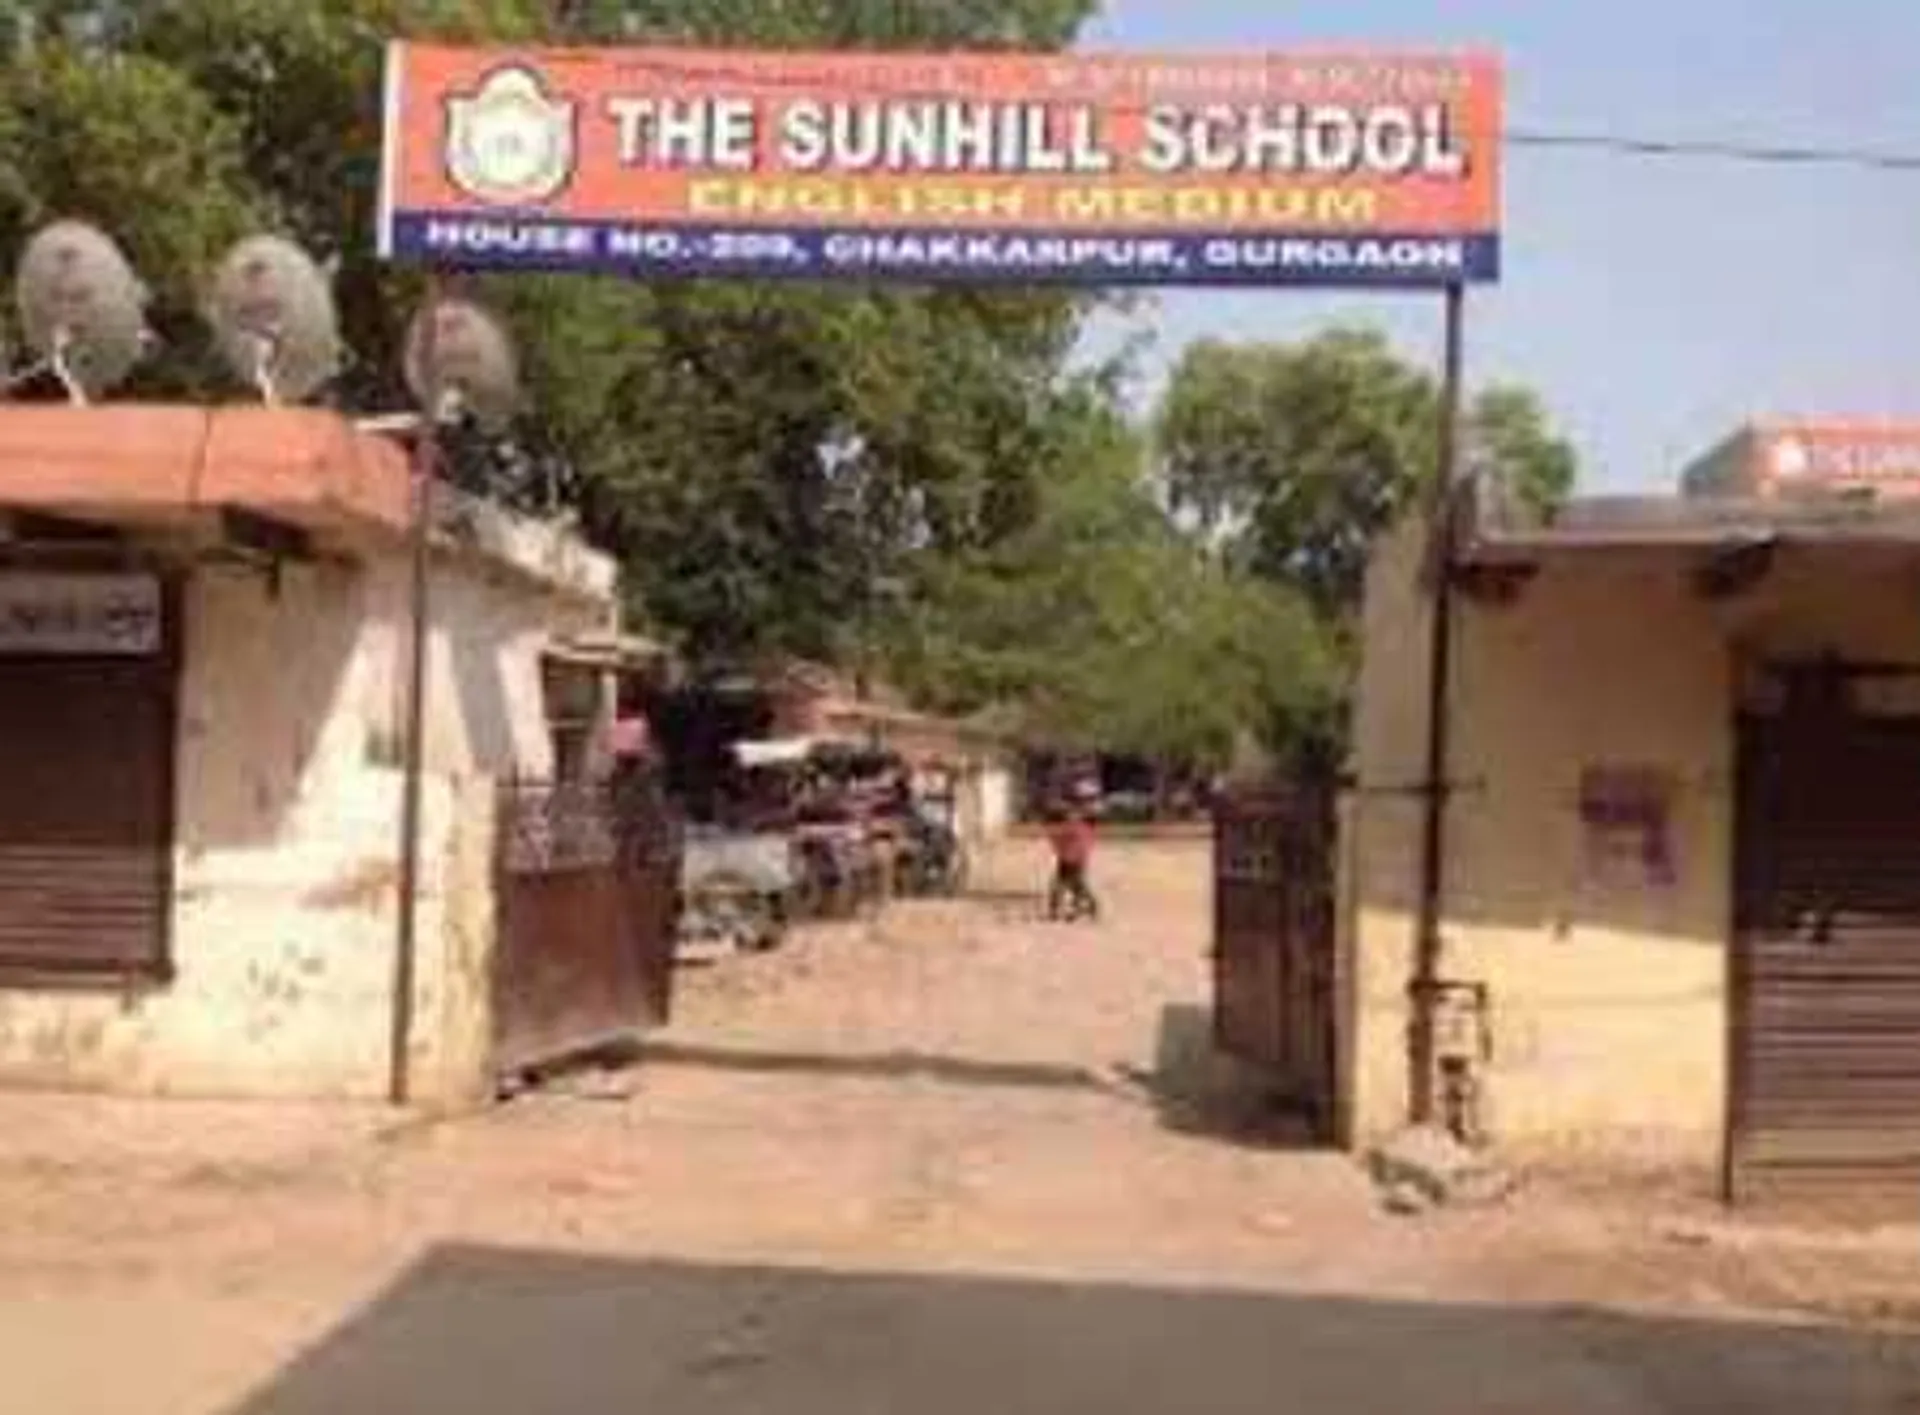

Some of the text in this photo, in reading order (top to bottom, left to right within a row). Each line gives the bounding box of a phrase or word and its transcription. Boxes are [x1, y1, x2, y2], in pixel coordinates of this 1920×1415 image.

[608, 97, 1466, 174] THE SUNHILL SCHOOL
[688, 178, 1378, 222] ENGLISH MEDIUM
[425, 220, 594, 253] HOUSE
[1205, 238, 1463, 266] GURGAON
